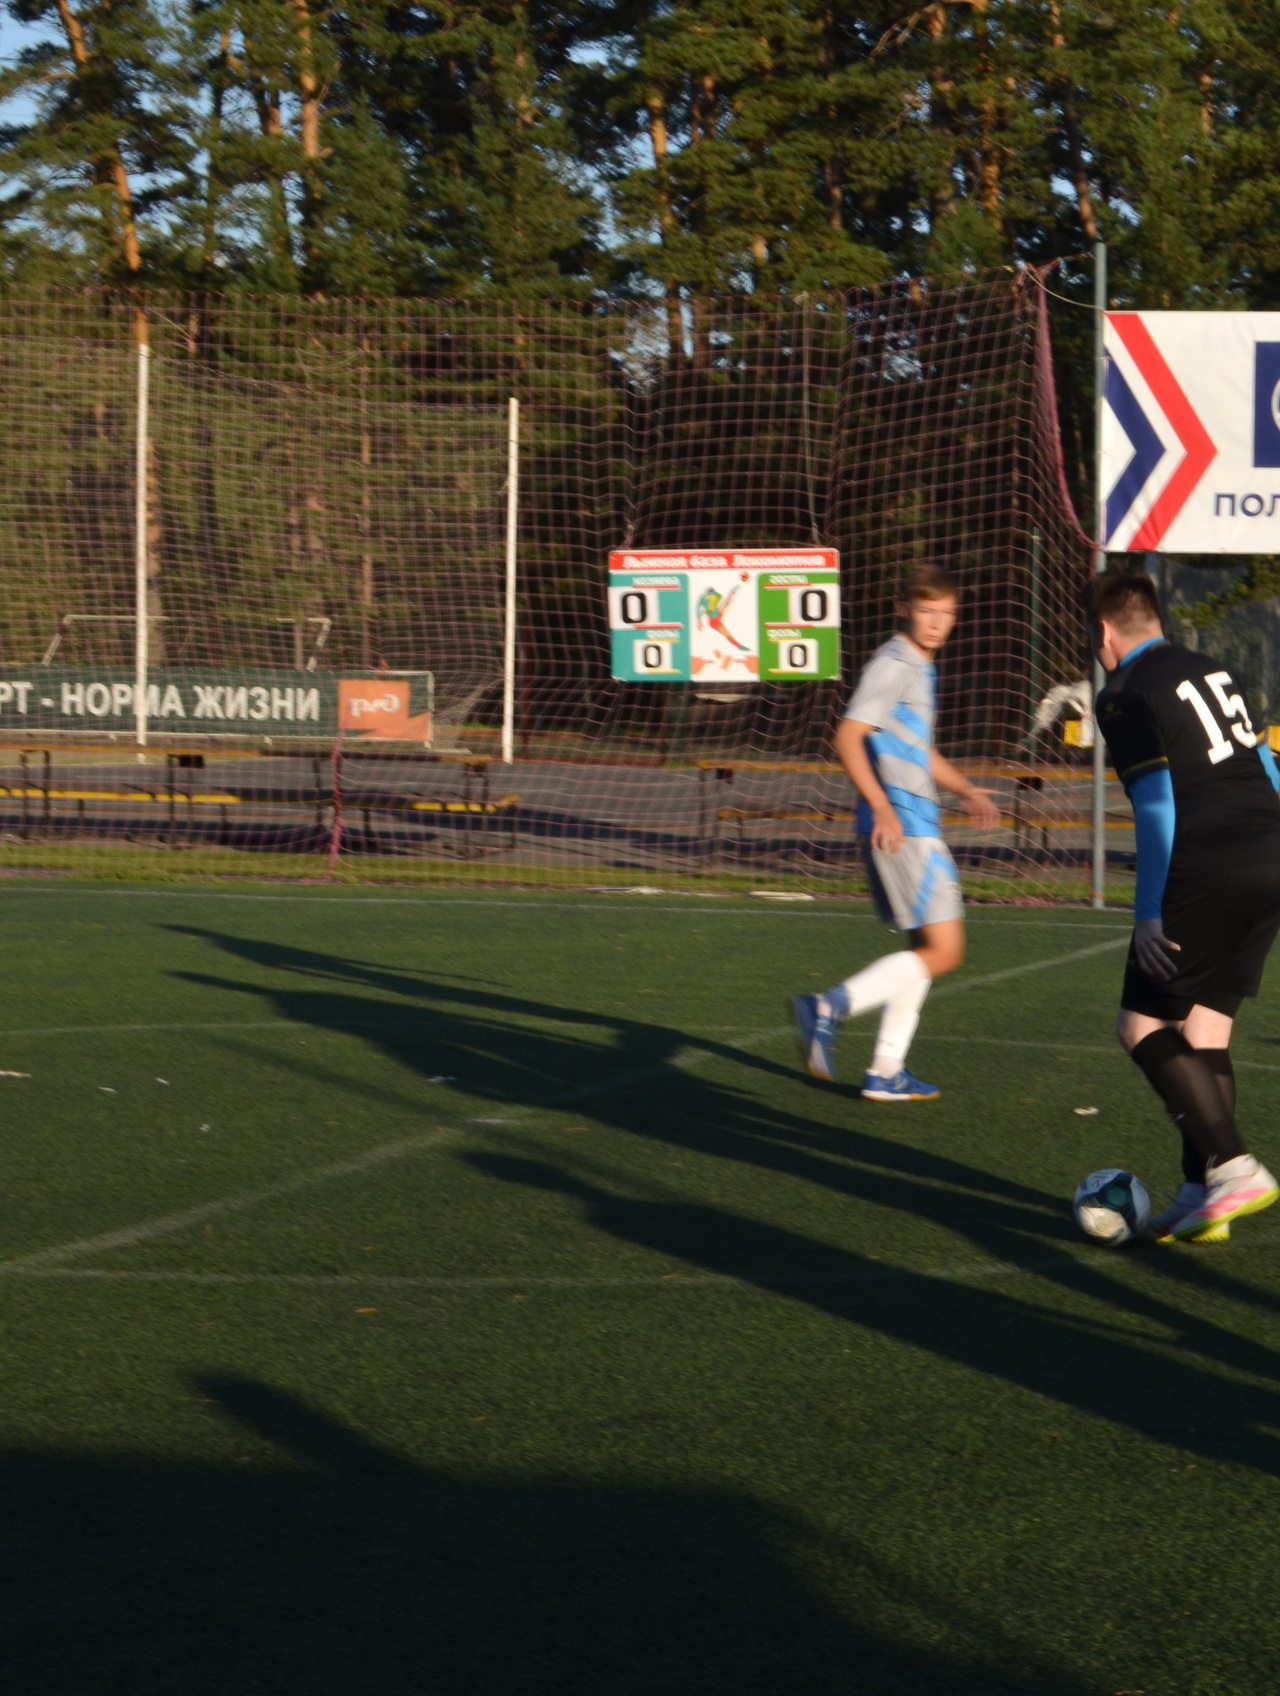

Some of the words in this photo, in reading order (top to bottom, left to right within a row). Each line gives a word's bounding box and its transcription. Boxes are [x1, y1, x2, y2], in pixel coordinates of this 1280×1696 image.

[689, 555, 728, 568] база
[621, 592, 648, 624] 0
[801, 590, 828, 622] 0
[644, 643, 662, 668] 0
[789, 643, 808, 668] 0
[61, 682, 187, 719] НОРМА
[192, 685, 321, 723] ЖИЗНИ
[1175, 670, 1258, 765] 15
